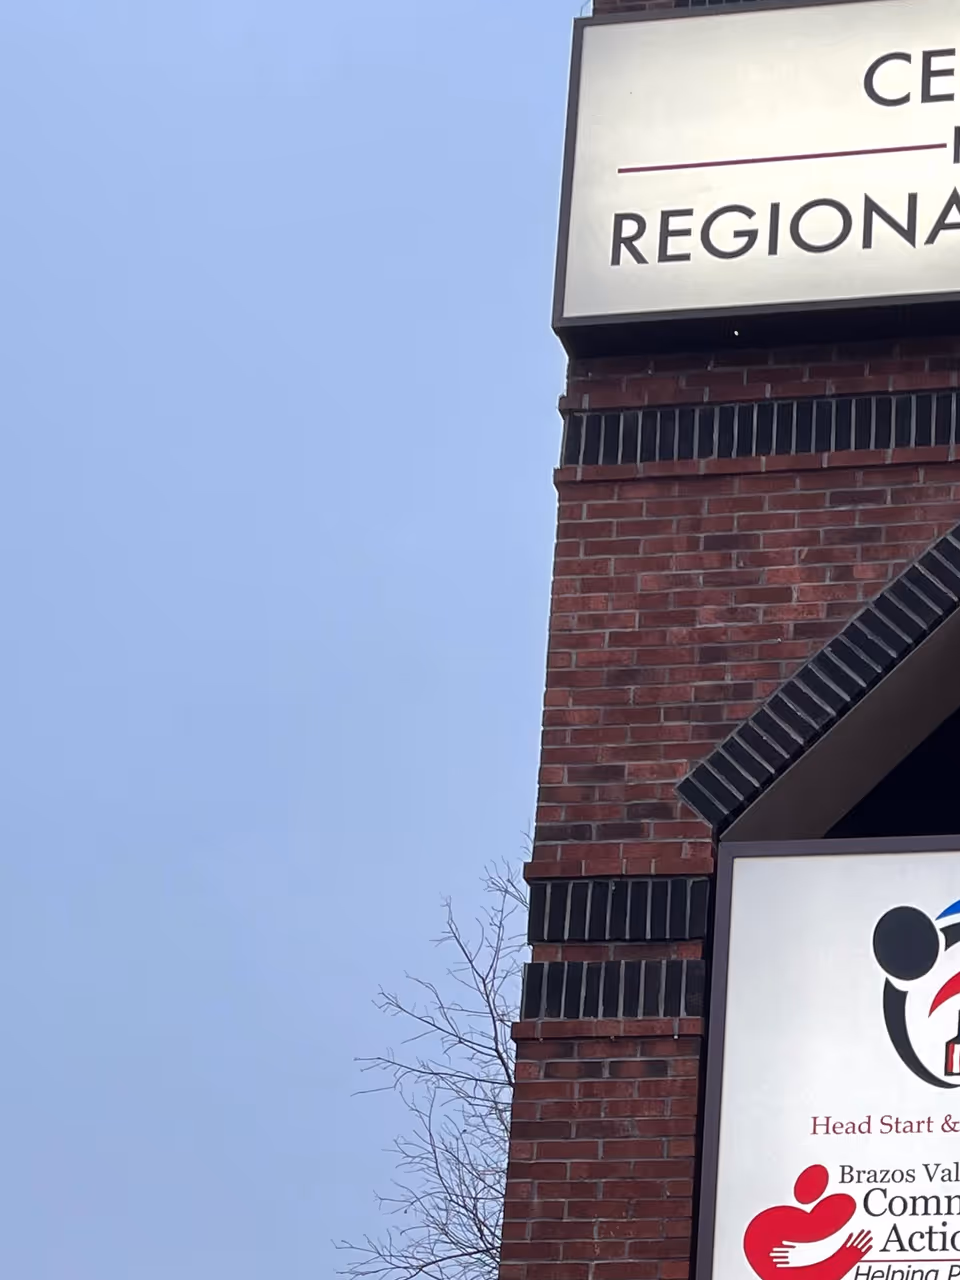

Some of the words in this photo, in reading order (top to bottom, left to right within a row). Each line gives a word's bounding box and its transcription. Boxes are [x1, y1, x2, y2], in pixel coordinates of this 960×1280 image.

[811, 1115, 872, 1134] Head
[880, 1115, 933, 1134] Start
[941, 1114, 960, 1132] &
[839, 1165, 915, 1183] Brazos
